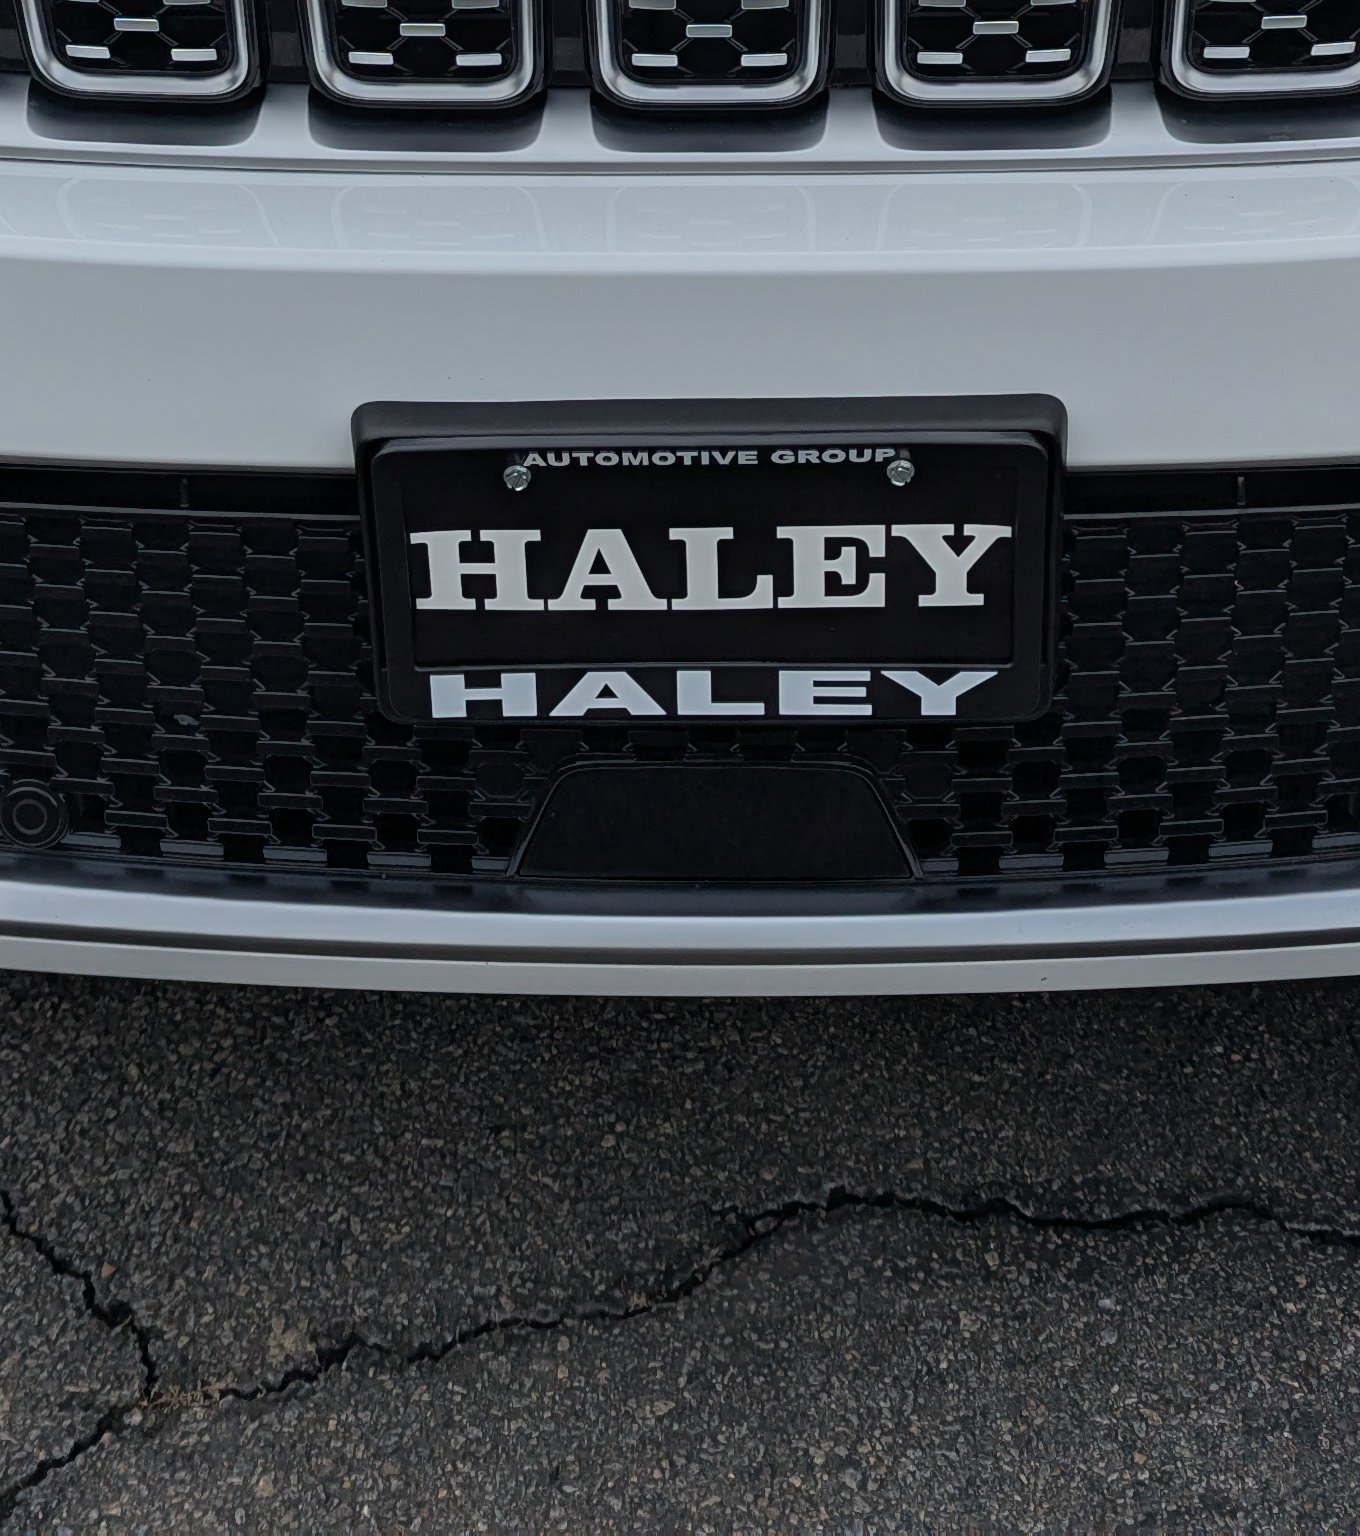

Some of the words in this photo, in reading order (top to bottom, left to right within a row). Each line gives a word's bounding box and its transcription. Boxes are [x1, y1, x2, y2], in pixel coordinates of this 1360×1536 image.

[524, 450, 758, 467] AUTOMOTIVE
[770, 448, 897, 465] GROUP
[409, 524, 1013, 612] HALEY
[429, 669, 999, 719] HALEY
